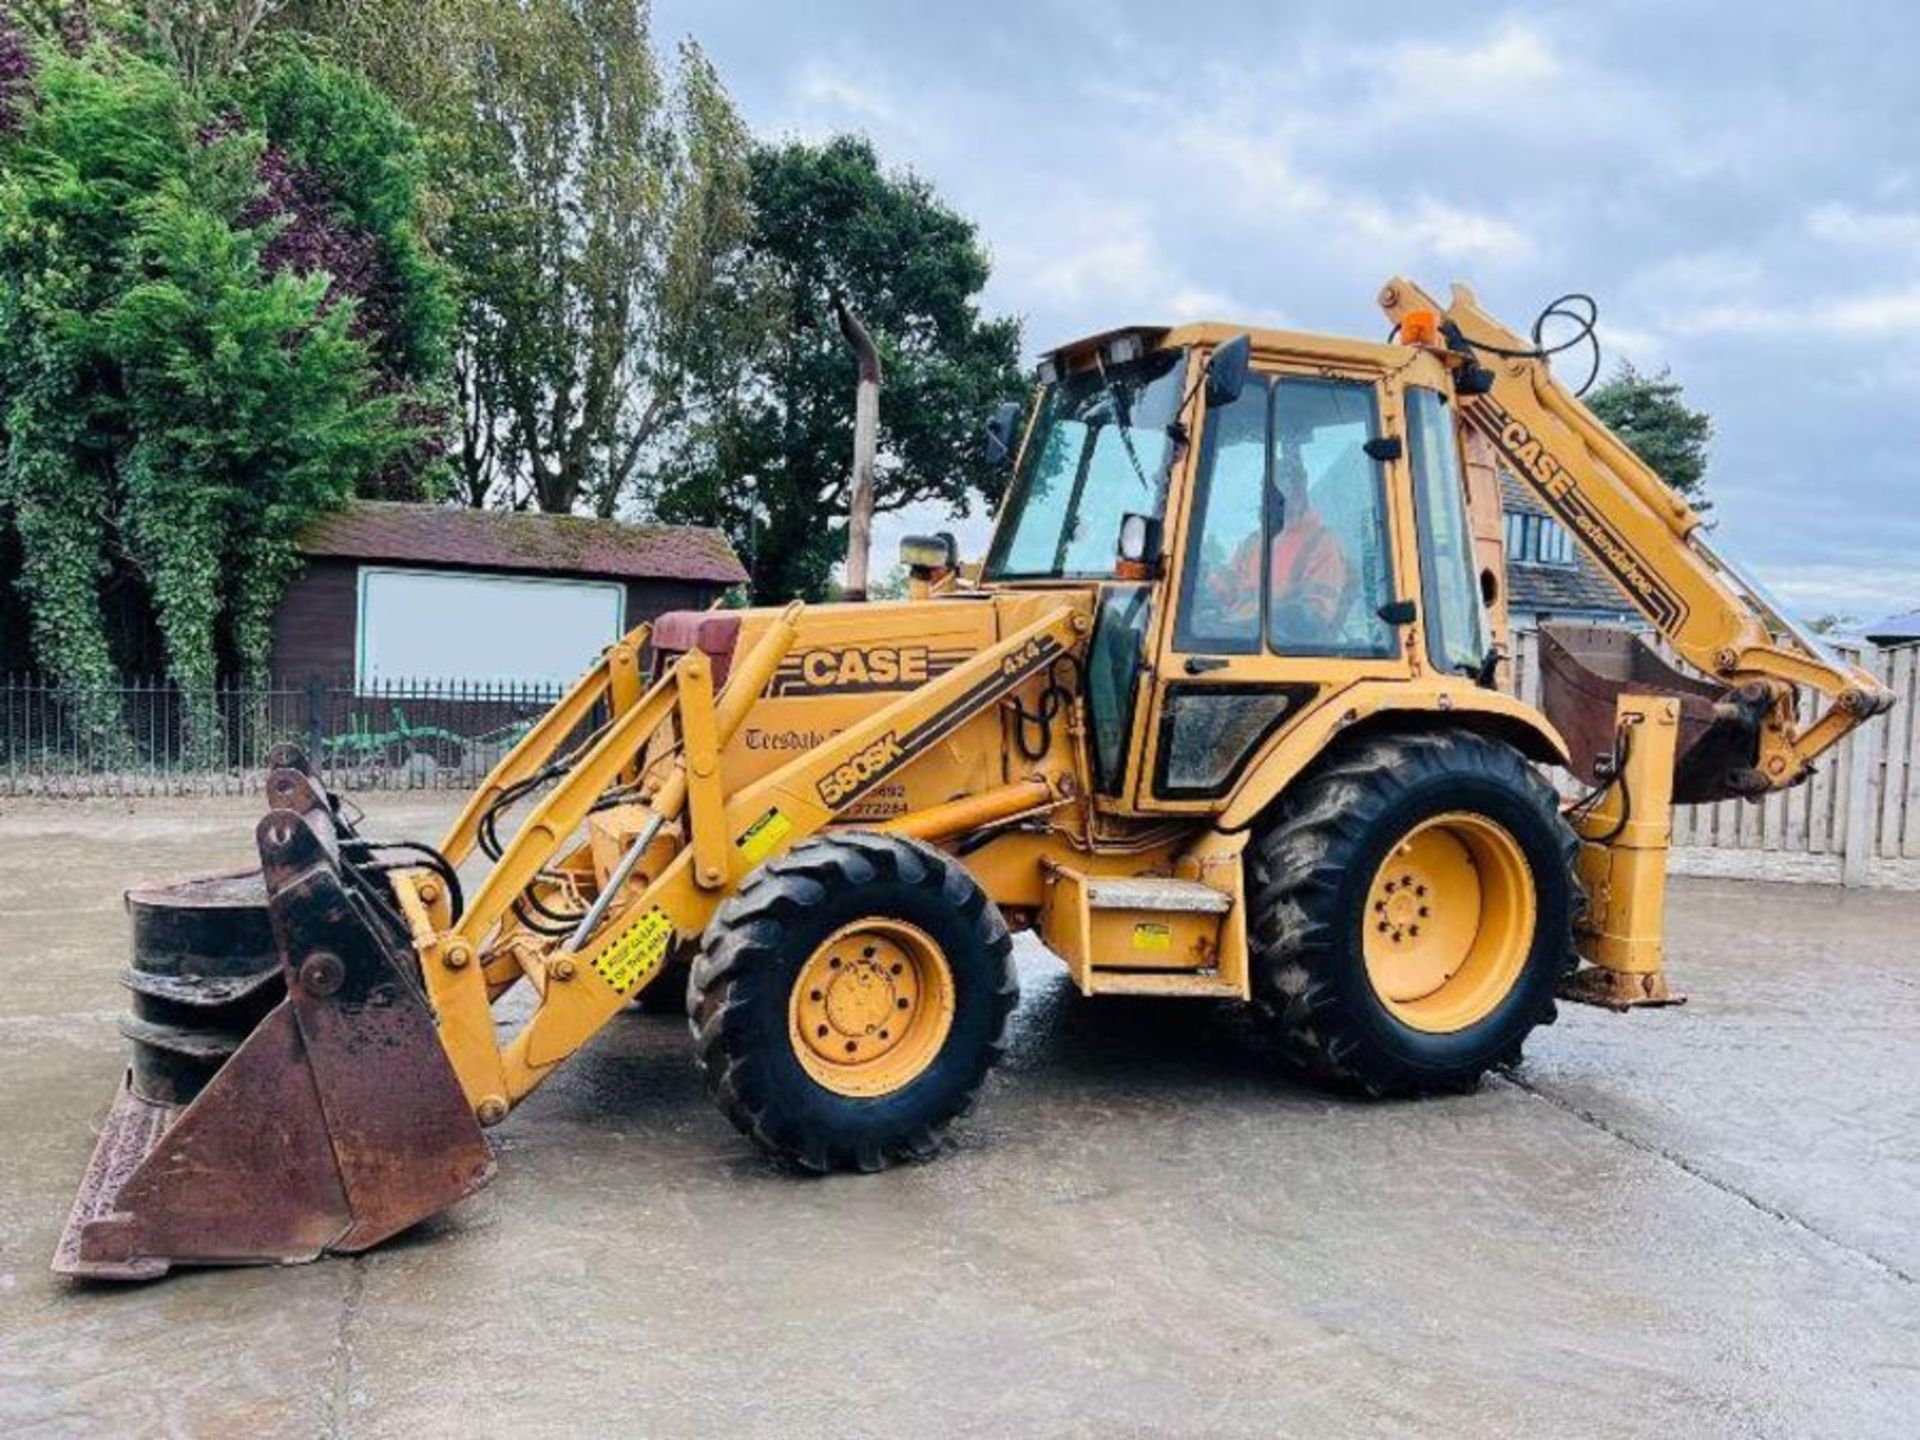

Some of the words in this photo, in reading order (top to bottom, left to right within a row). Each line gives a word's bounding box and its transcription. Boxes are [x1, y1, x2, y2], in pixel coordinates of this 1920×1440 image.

[1501, 420, 1574, 501] CASE
[803, 648, 928, 686] CASE
[1002, 640, 1041, 676] 4x4
[818, 733, 905, 805] 580SK
